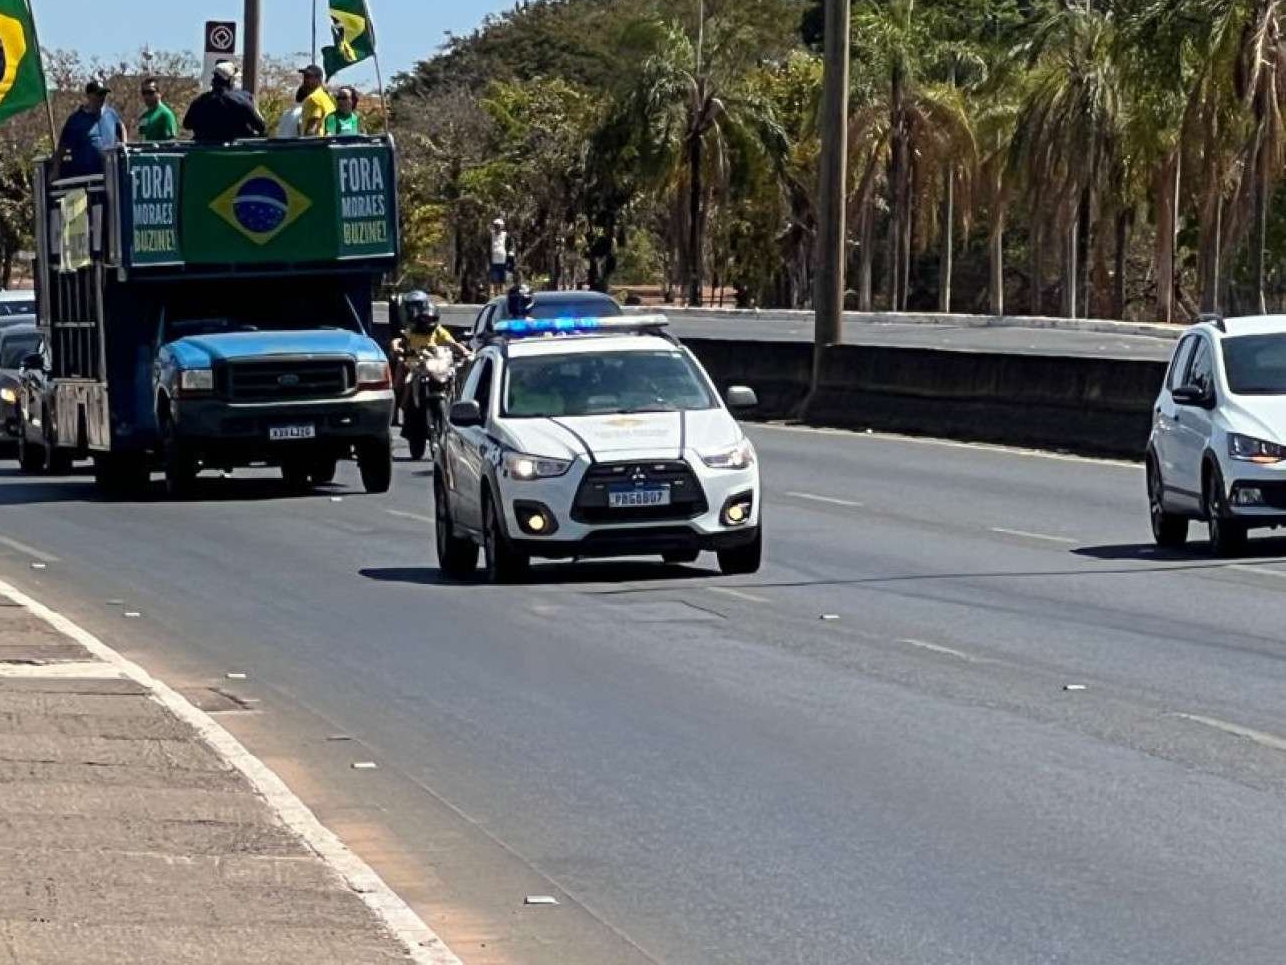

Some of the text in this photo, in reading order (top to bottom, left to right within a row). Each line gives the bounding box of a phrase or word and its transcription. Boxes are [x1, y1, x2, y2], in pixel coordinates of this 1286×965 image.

[131, 165, 174, 199] FORA
[339, 156, 384, 192] FORA
[133, 203, 173, 224] MORAES
[341, 195, 385, 218] MORAES
